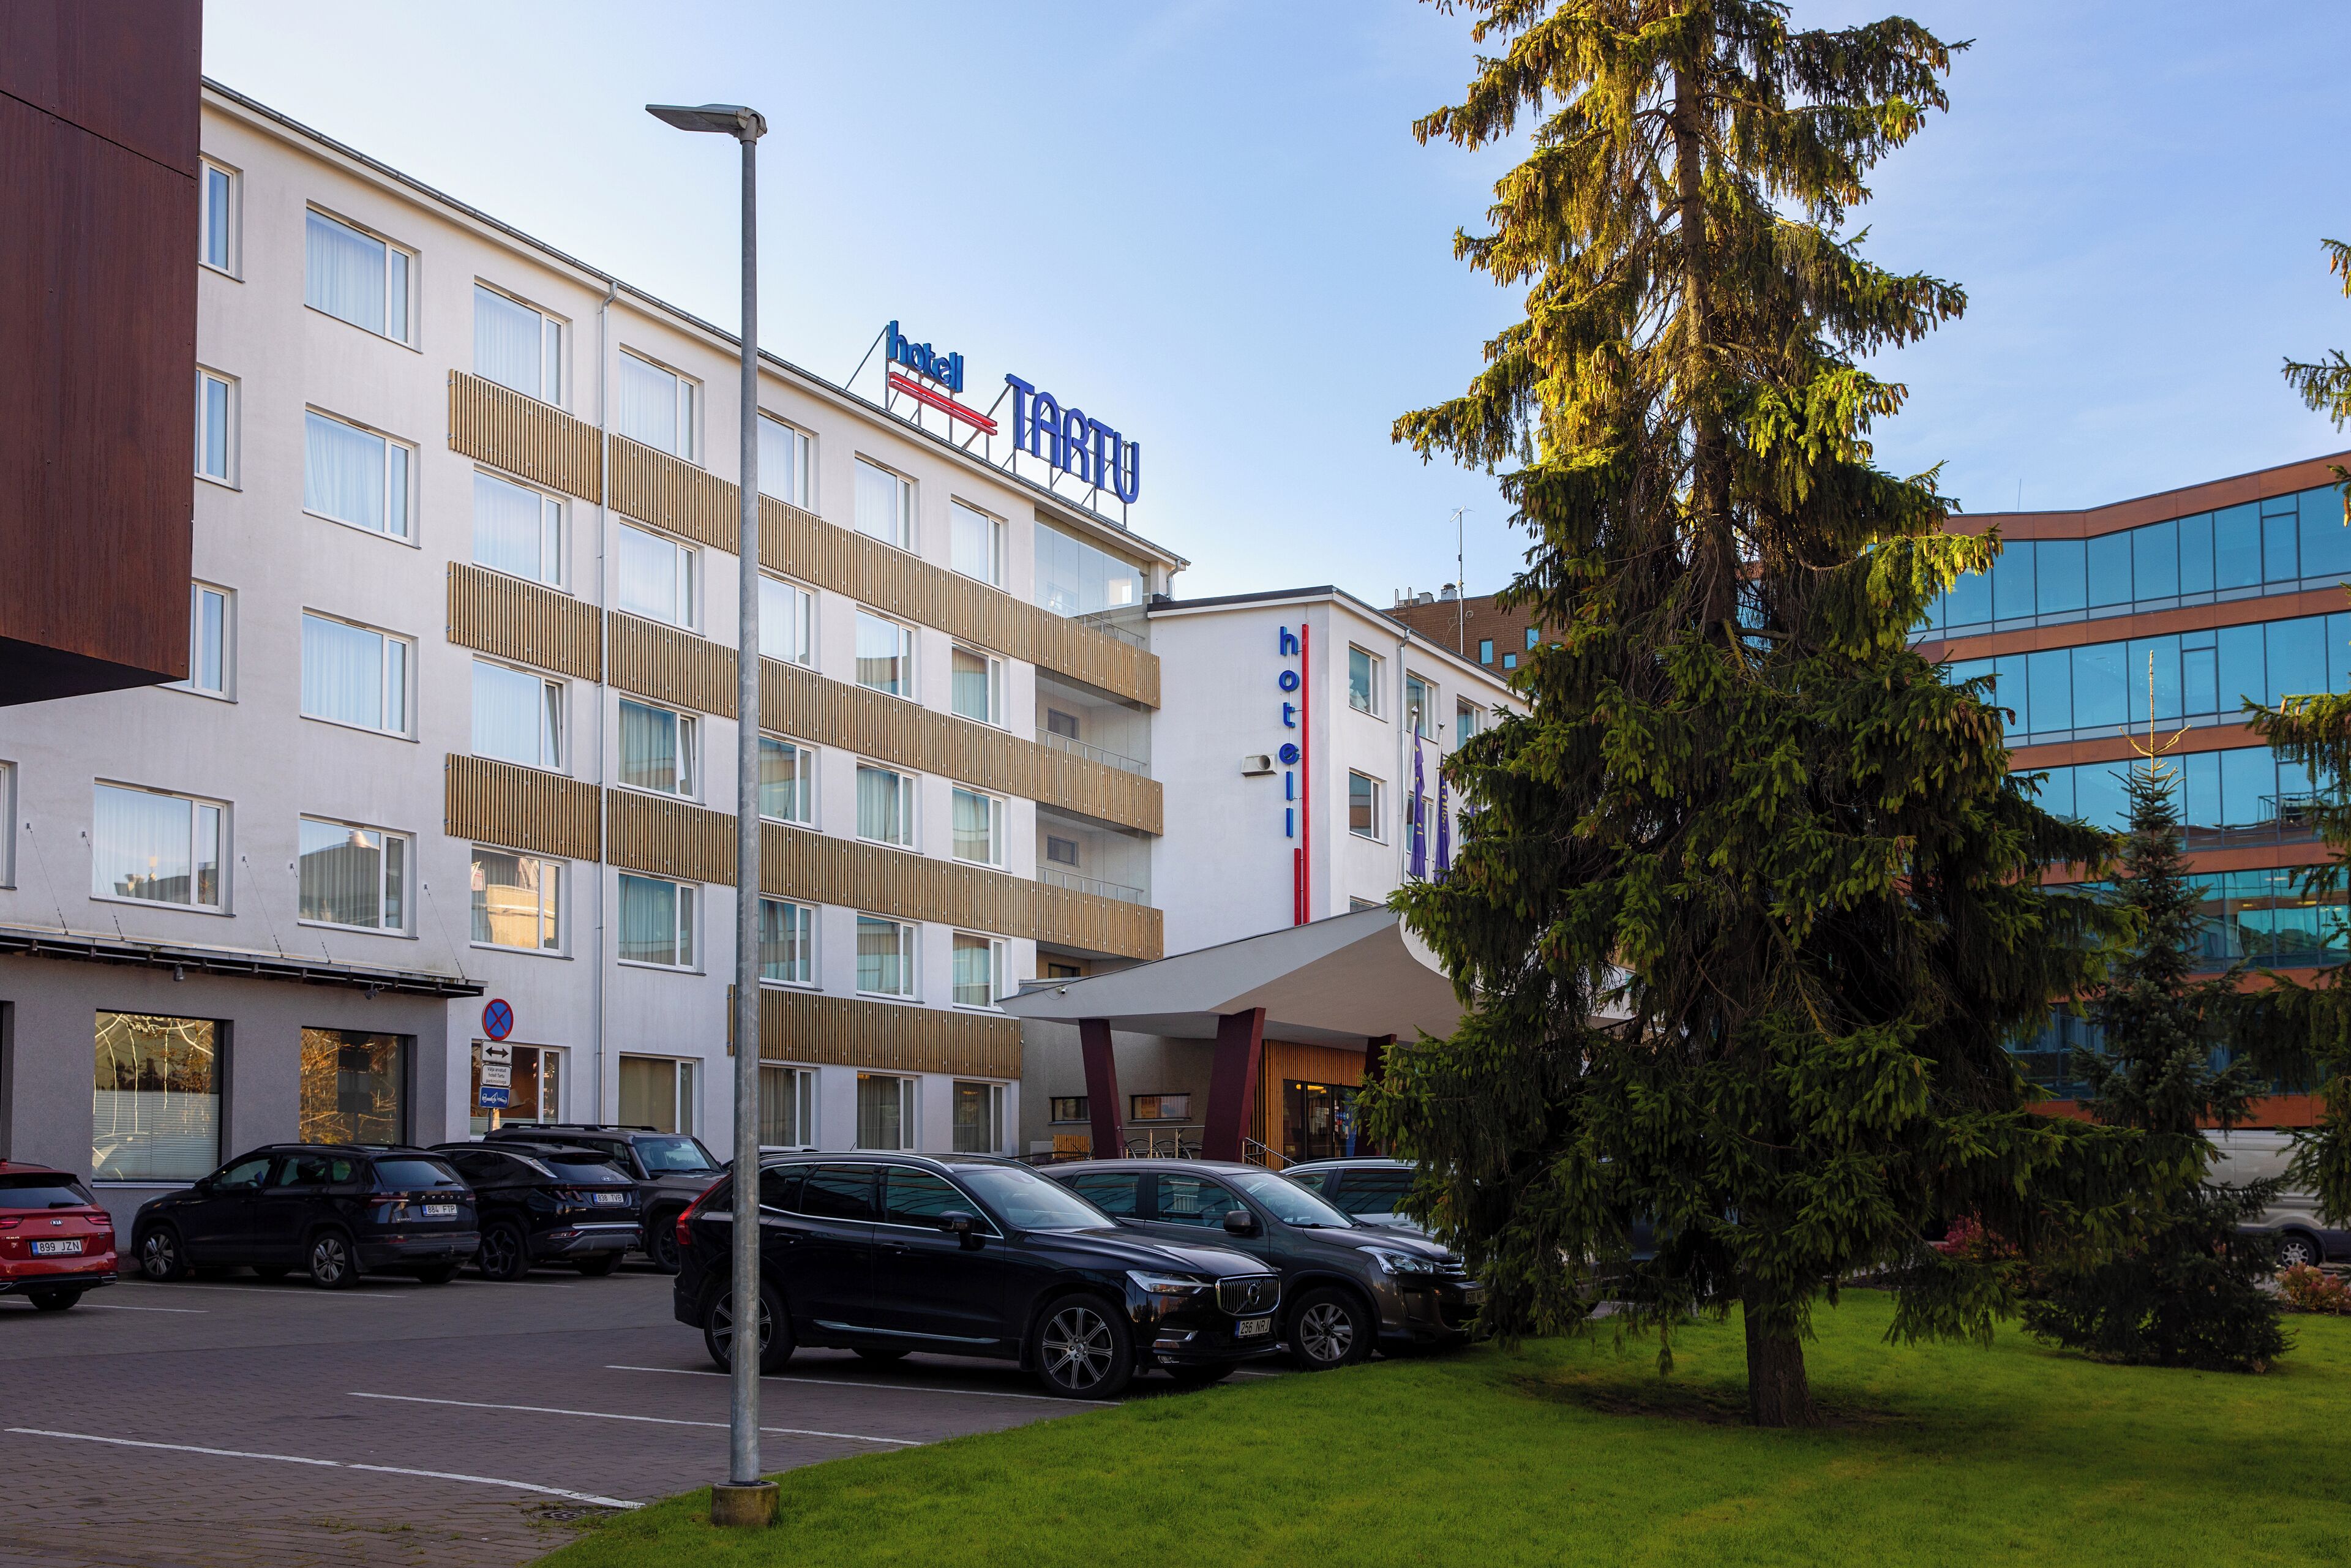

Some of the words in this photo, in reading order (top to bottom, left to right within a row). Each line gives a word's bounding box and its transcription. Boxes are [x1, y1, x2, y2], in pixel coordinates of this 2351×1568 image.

[888, 320, 964, 394] hotell
[1005, 373, 1139, 505] TARTU
[1279, 626, 1300, 838] hotell
[40, 1242, 56, 1252] 899
[61, 1241, 80, 1251] JZN
[1240, 1321, 1253, 1334] 256
[1256, 1319, 1269, 1333] NRJ
